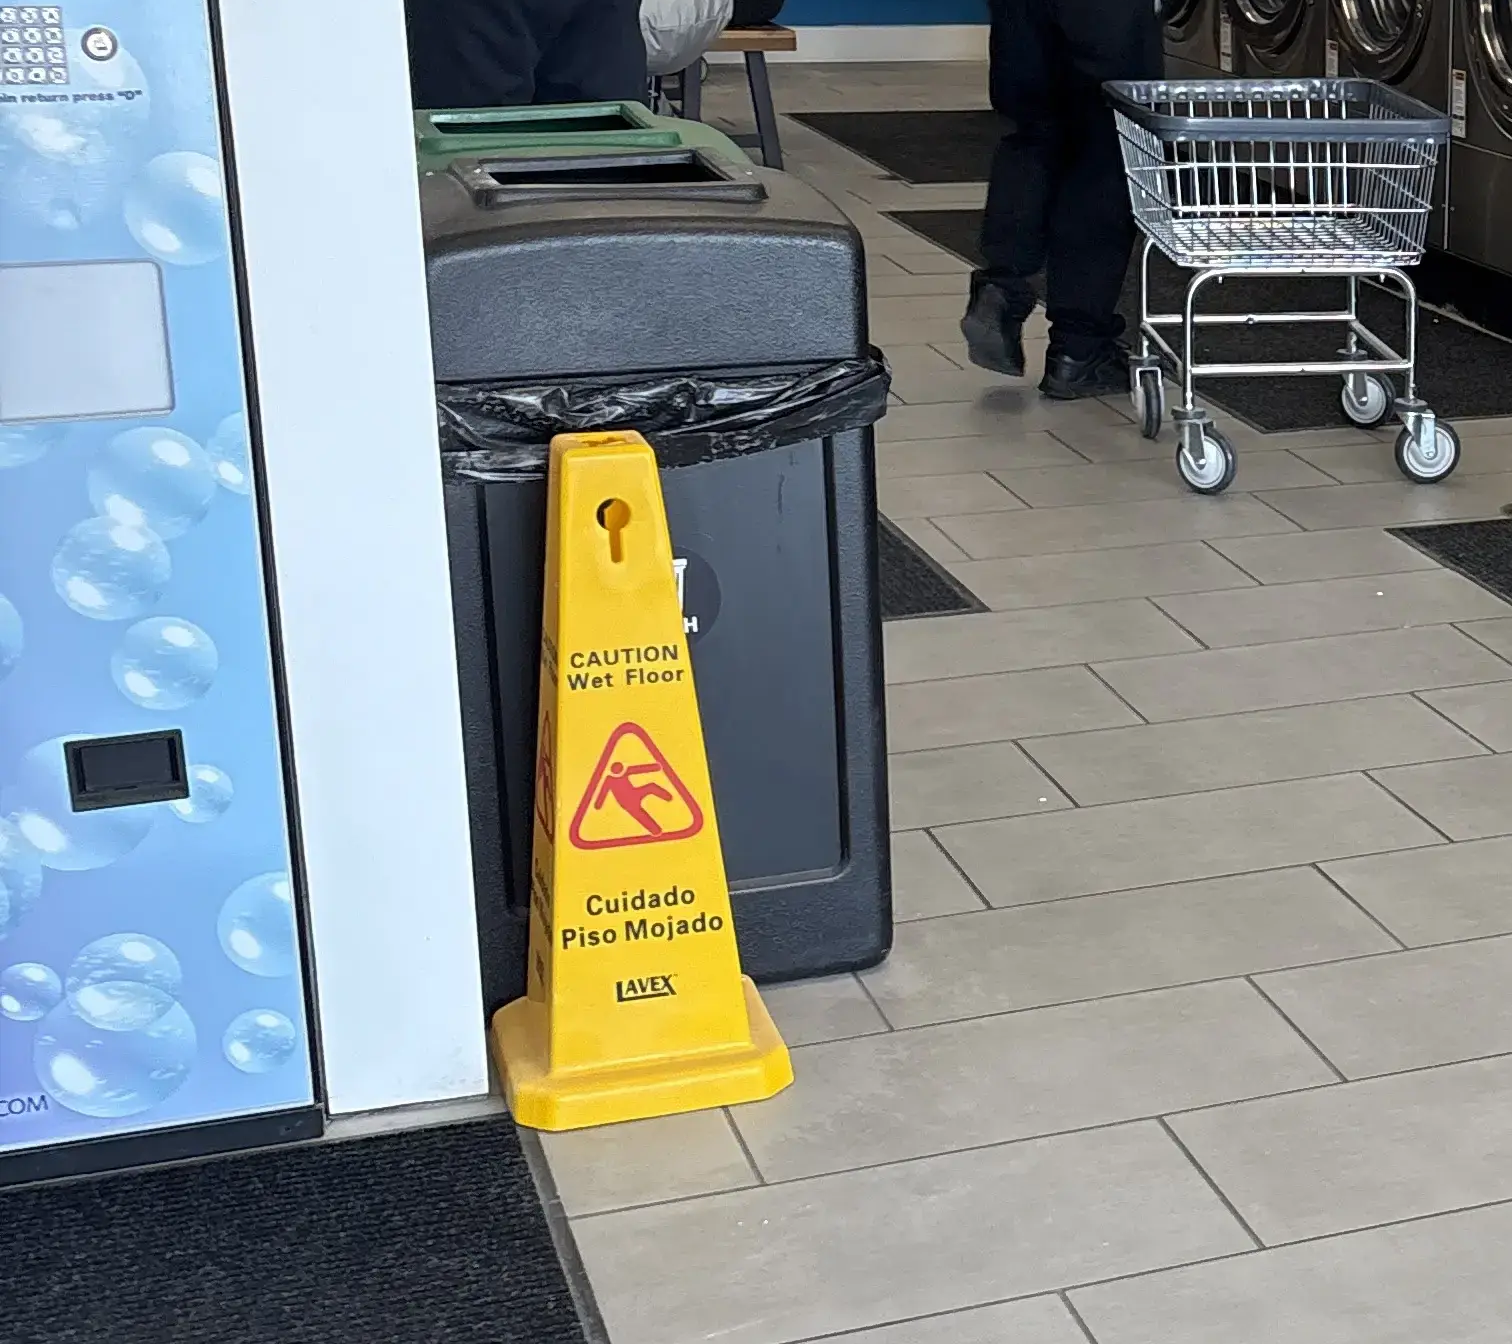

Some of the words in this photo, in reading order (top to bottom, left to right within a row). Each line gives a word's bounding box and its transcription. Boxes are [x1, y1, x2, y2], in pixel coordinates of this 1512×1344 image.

[72, 92, 115, 104] press
[570, 644, 679, 669] CAUTION
[567, 671, 614, 691] Wet
[626, 668, 684, 686] Floor
[586, 885, 695, 916] Cuidado
[561, 926, 617, 949] Piso
[624, 912, 723, 941] Mojado
[615, 973, 677, 1002] LAVEX
